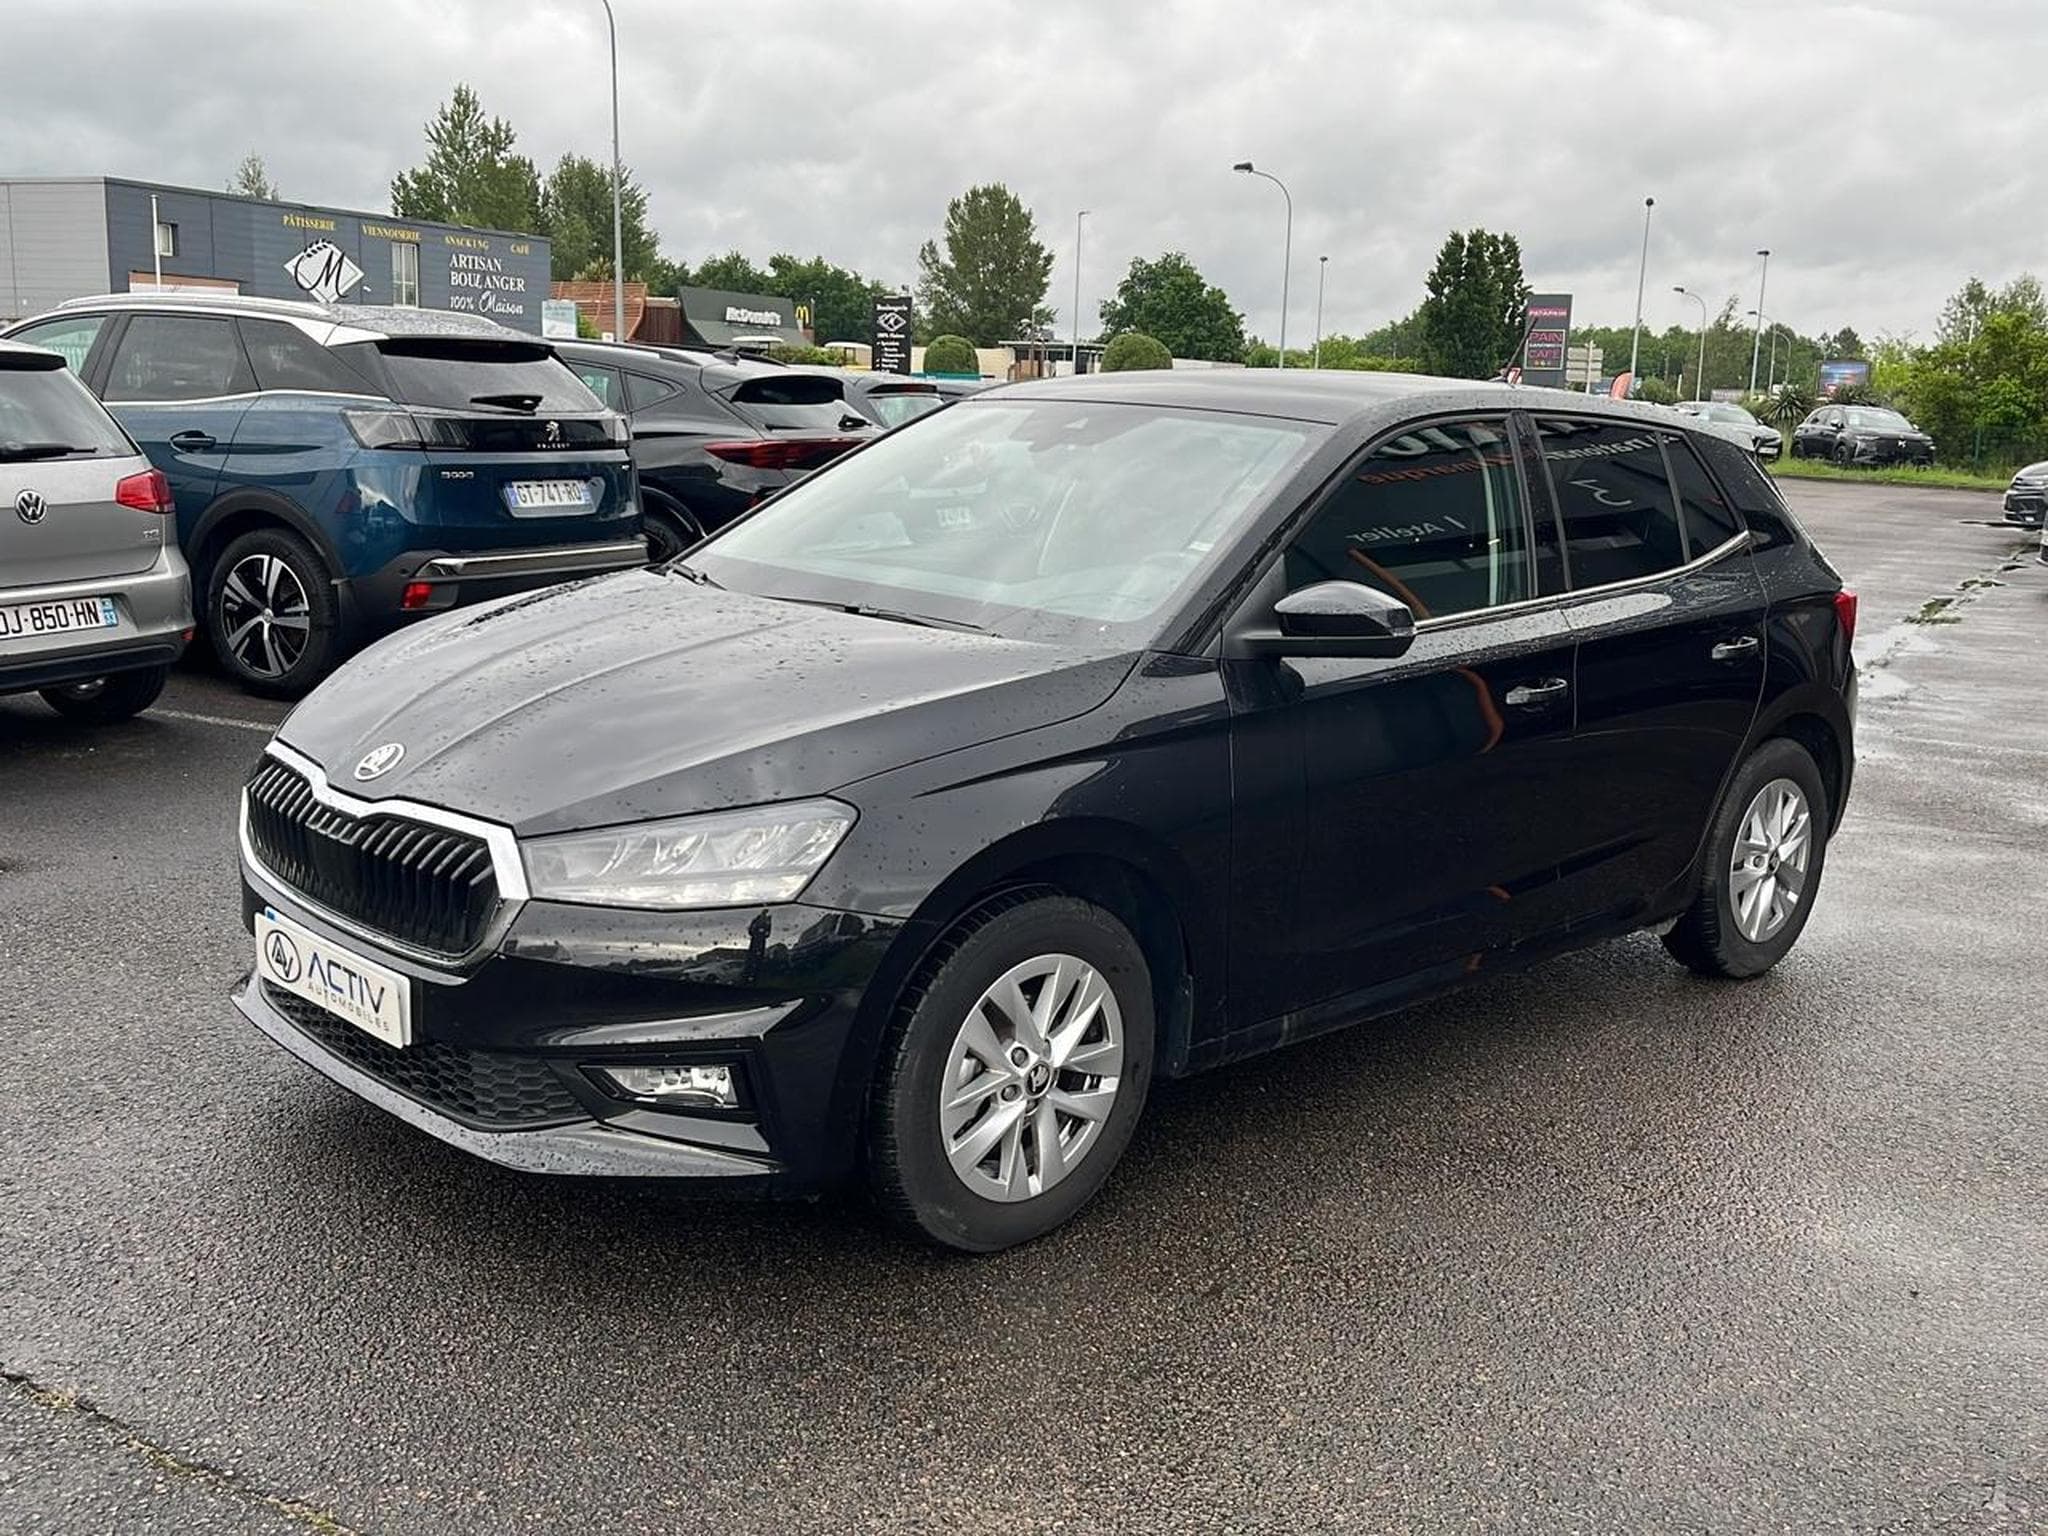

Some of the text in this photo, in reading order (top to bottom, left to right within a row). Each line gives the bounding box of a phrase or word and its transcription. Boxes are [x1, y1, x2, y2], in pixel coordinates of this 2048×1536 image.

[449, 254, 502, 273] ARTISAN
[450, 272, 525, 292] BOULANGER
[450, 296, 474, 310] 100%
[479, 291, 523, 314] Maison
[1529, 333, 1562, 342] PAIN
[308, 951, 385, 1014] ACTIV
[307, 981, 390, 1032] AUTOMOBILES
